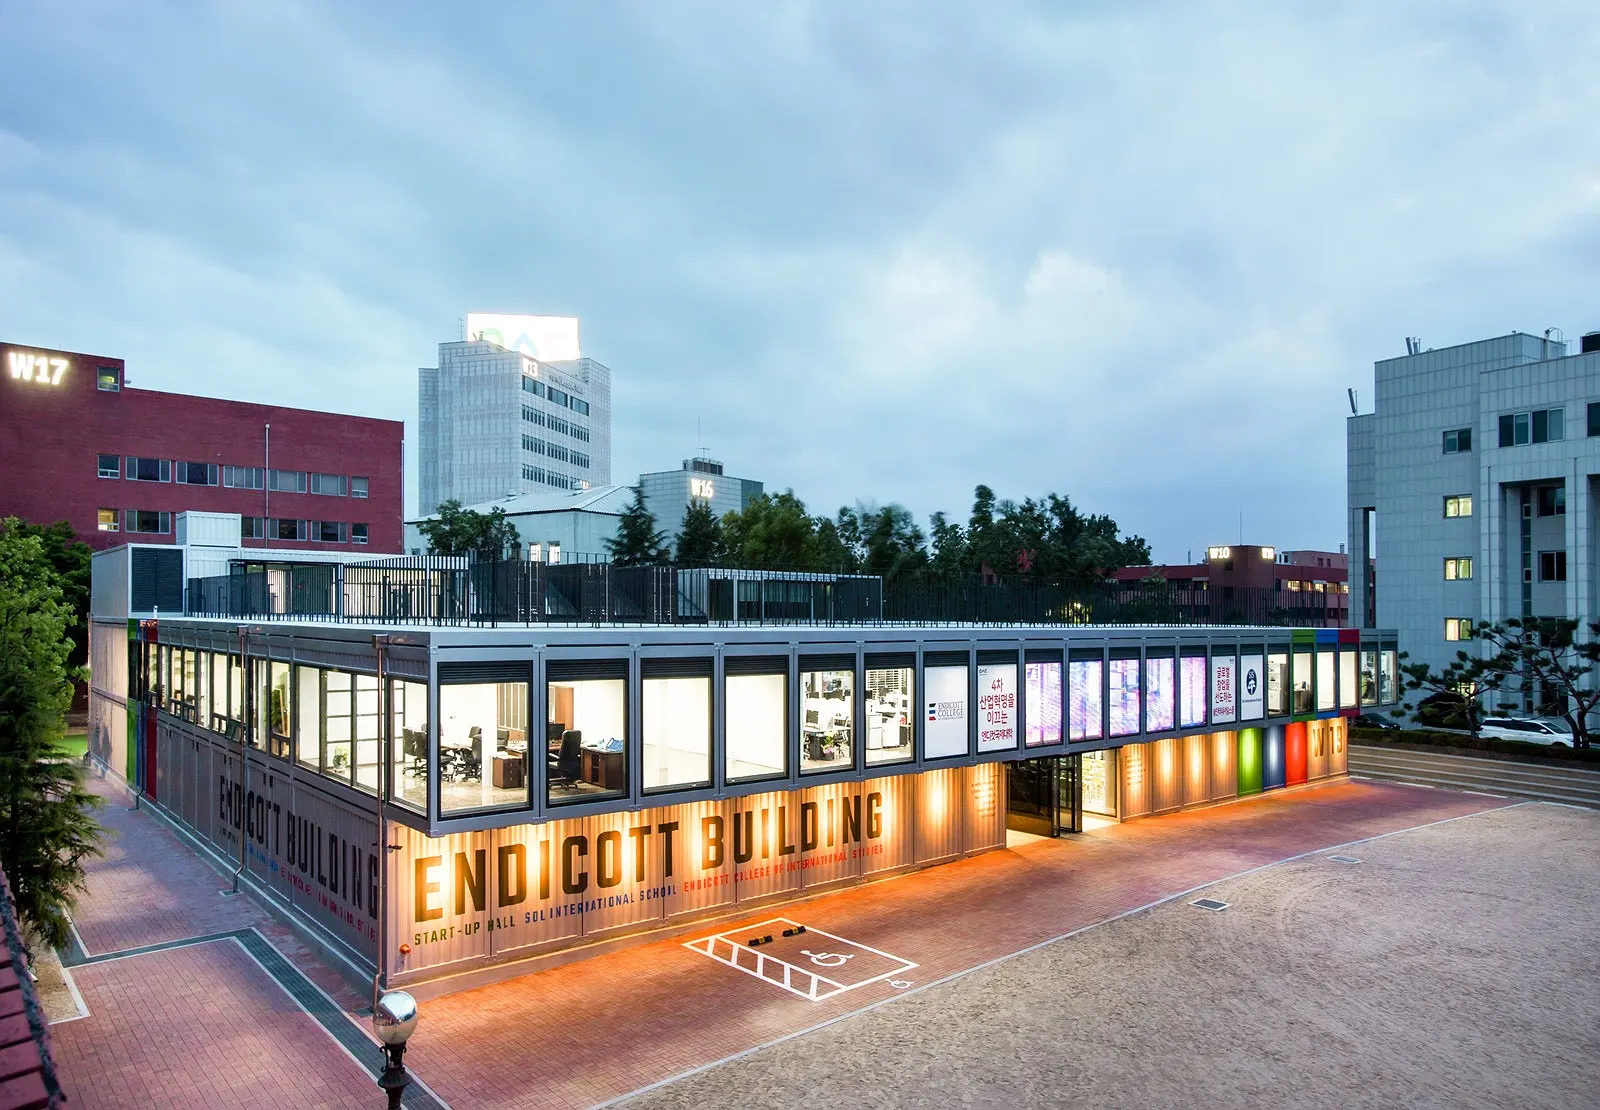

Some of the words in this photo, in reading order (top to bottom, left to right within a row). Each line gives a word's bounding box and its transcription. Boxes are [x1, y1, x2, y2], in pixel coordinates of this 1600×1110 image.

[8, 352, 69, 385] W17
[691, 478, 713, 498] W16
[1209, 546, 1230, 559] W10
[992, 678, 1003, 692] 4차
[938, 701, 964, 710] ENDICOTT
[980, 693, 1014, 710] 산업혁명을
[938, 709, 963, 717] COLLEGE
[987, 710, 1008, 725] 이끄는
[220, 775, 280, 856] ENDCOTT
[286, 809, 377, 920] BUILDING
[414, 822, 679, 923] ENDICOTT
[701, 792, 883, 870] BUILDING
[414, 922, 481, 946] START-UP
[487, 915, 515, 932] HALL
[525, 909, 545, 924] SOL
[683, 874, 730, 892] ENDICOTT
[787, 851, 848, 872] INTERNATIONAL
